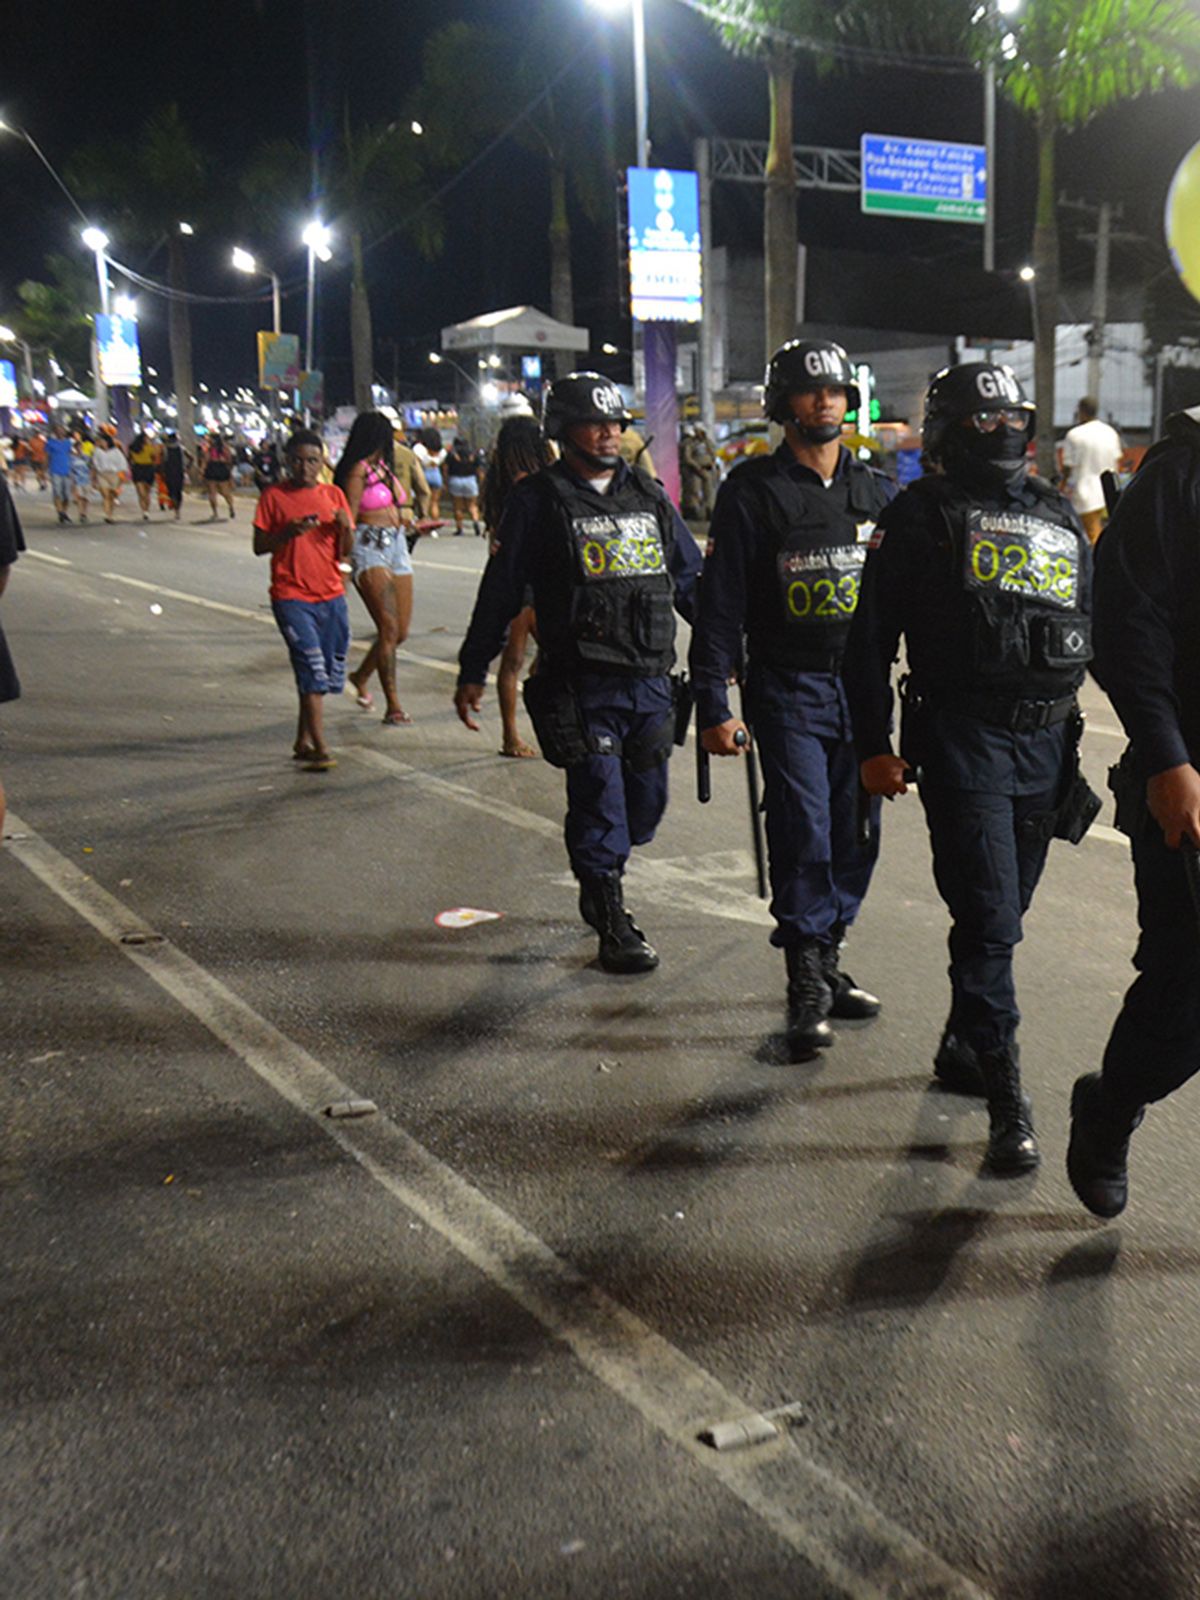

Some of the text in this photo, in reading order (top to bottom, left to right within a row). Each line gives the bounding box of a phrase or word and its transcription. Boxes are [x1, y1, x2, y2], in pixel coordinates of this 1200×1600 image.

[804, 350, 842, 377] GM
[592, 386, 622, 413] GM
[976, 368, 1019, 403] GM
[583, 537, 661, 573] 0235
[972, 540, 1073, 599] 0238
[788, 575, 861, 616] 023
